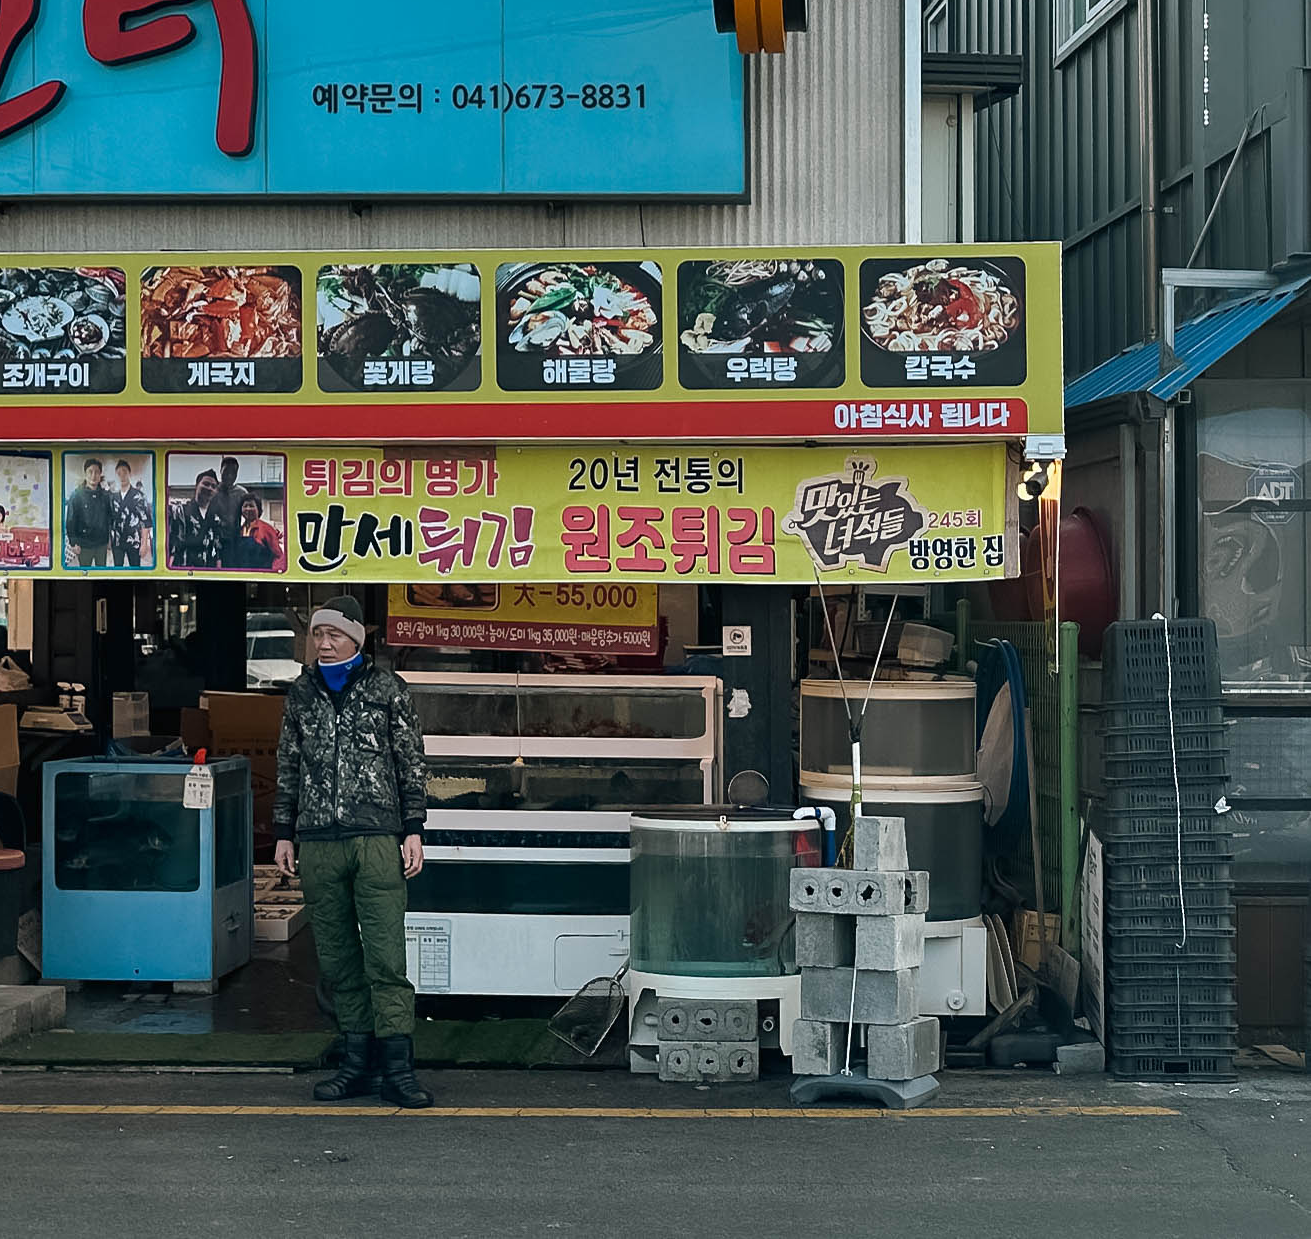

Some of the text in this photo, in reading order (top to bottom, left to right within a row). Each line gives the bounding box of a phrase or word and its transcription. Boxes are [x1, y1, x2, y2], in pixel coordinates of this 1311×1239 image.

[312, 82, 423, 114] 예약문의
[451, 82, 646, 113] 041)673-8831
[2, 362, 91, 388] 조개구이
[187, 362, 256, 387] 게국지
[363, 359, 436, 386] 꽃게탕
[542, 358, 616, 385] 해물탕
[726, 357, 798, 383] 우럭탕
[904, 355, 976, 381] 칼국수
[833, 401, 932, 429] 아침식사
[940, 401, 1010, 428] 됩니다
[301, 458, 499, 498] 튀김의 명가
[568, 456, 745, 495] 20년 전통의
[801, 470, 905, 556] 맛있는 녀석들
[928, 509, 982, 529] 245회
[296, 503, 535, 575] 만세튀김
[560, 503, 776, 576] 원조튀김
[908, 534, 1004, 571] 방영한 집
[396, 621, 434, 640] 우럭/광어
[435, 623, 450, 641] 1kg
[528, 627, 541, 645] 1kg
